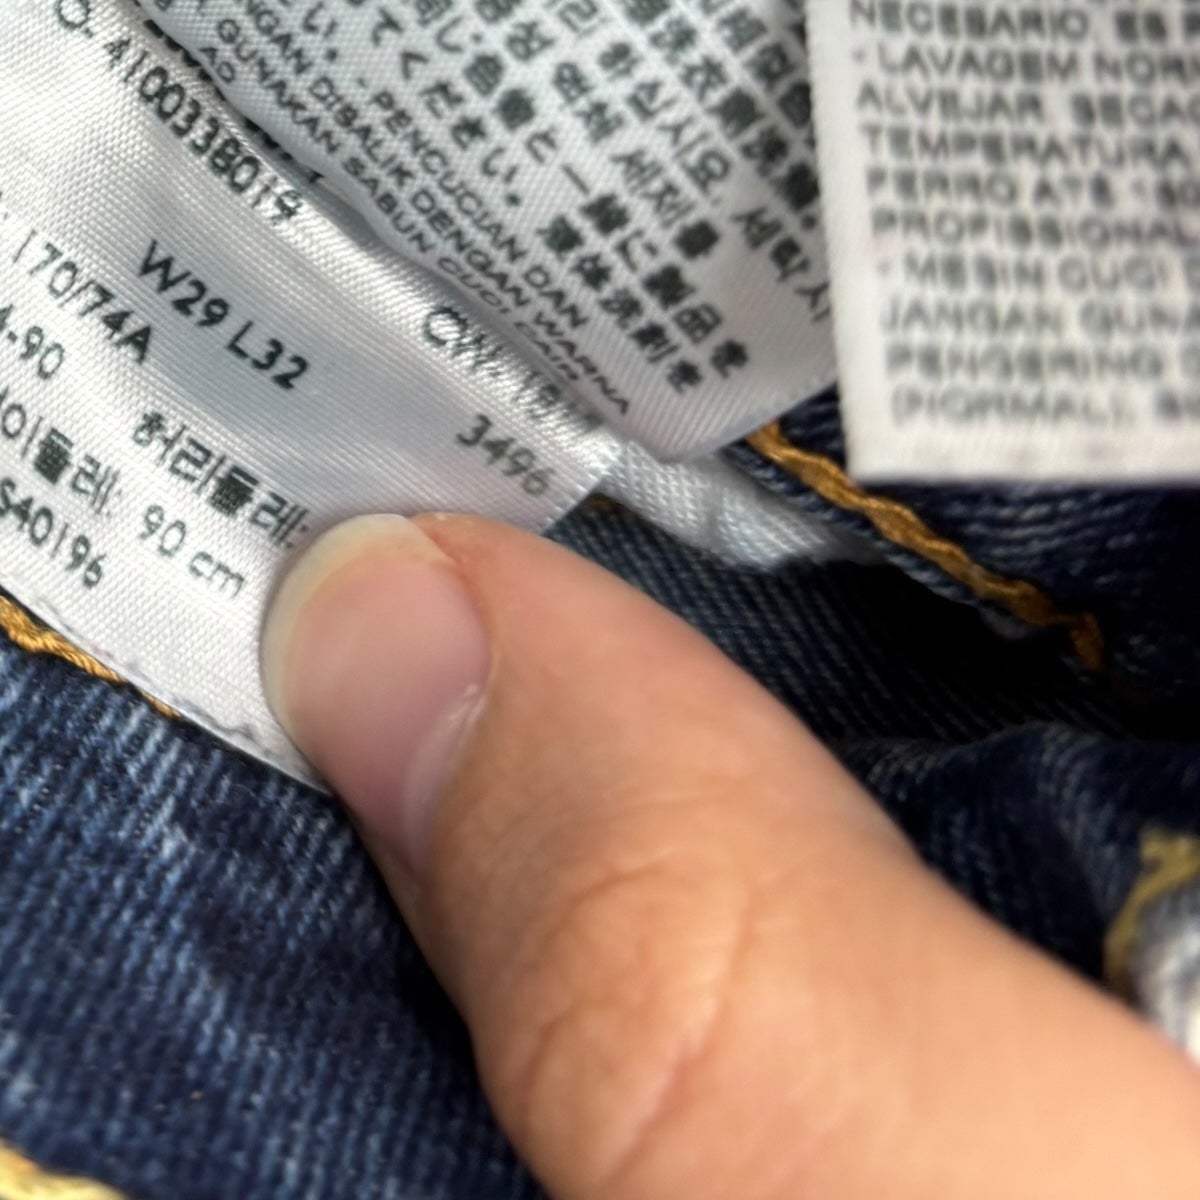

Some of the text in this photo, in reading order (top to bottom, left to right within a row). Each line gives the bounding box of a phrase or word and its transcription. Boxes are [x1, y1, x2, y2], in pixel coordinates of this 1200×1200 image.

[211, 13, 344, 160] GUNAKAN
[340, 152, 435, 258] SABUN
[367, 86, 528, 267] PENCUCIAN
[522, 262, 590, 333] DAN
[9, 228, 163, 367] 170/74A
[129, 239, 311, 396] W29 L32
[307, 73, 414, 190] DIBALIK
[408, 185, 532, 313] DENGAN
[529, 309, 634, 418] WARNA
[453, 409, 559, 503] 3496
[129, 500, 195, 562] 90
[184, 547, 249, 603] cm
